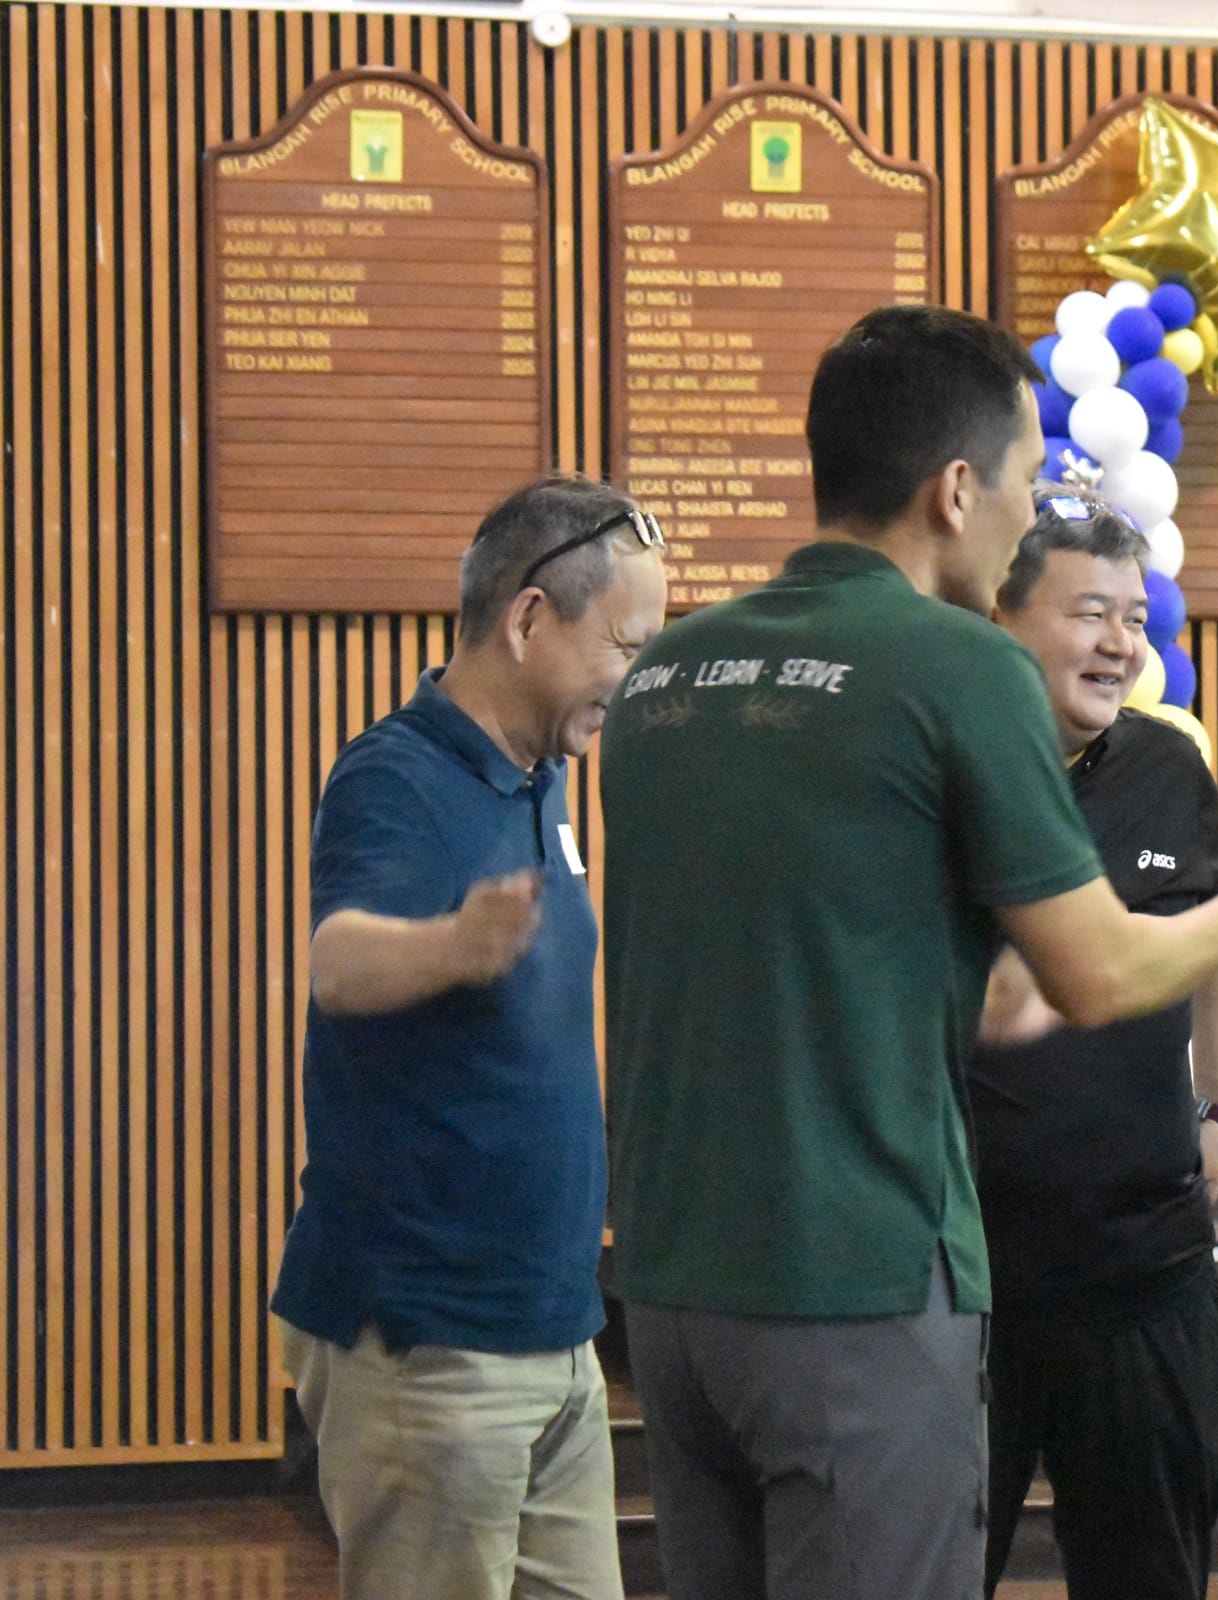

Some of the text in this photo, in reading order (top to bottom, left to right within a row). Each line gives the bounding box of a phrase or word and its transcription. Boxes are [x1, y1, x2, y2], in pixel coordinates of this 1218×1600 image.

[220, 84, 531, 184] BLANGAH RISE PRIMARY SCHOOL
[626, 96, 926, 193] BLANGAH RISE PRIMARY SCHOOL
[1015, 149, 1100, 197] BLANGAH
[323, 194, 432, 211] HEAD PREFECTS
[722, 202, 829, 221] HEAD PREFECTS
[225, 285, 287, 301] NGUYEN
[226, 353, 254, 369] TEO
[258, 354, 283, 370] KAI
[627, 355, 681, 370] MARCUS
[629, 480, 752, 496] LUCAS CHAN YI REN
[671, 586, 688, 602] DE
[775, 658, 853, 694] SERVE
[1152, 853, 1176, 870] asics
